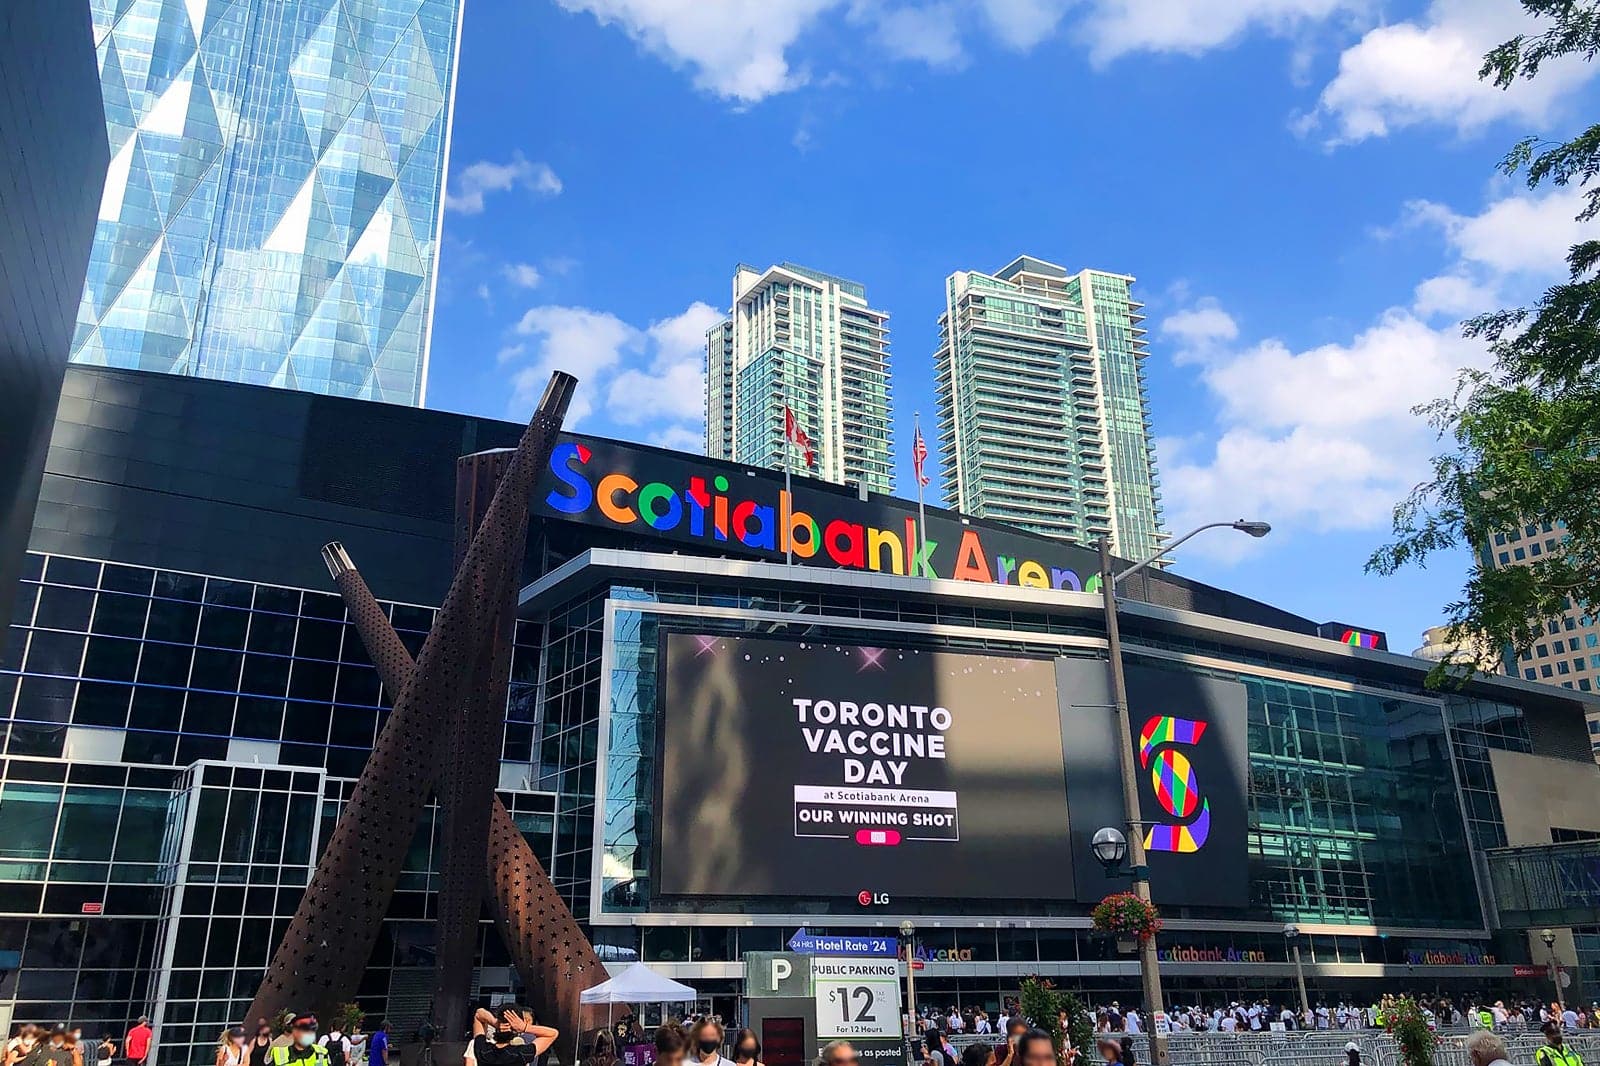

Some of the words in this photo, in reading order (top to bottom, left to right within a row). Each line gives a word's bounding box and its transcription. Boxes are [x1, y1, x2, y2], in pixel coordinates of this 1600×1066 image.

[545, 442, 939, 579] Scotiabank
[793, 698, 952, 731] TORONTO
[801, 727, 945, 760] VACCINE
[844, 758, 908, 786] DAY
[823, 791, 834, 800] at
[837, 791, 896, 802] Scotiabank
[899, 794, 930, 804] Arena
[798, 809, 834, 823] OUR
[838, 811, 908, 826] WINNING
[913, 813, 954, 827] SHOT
[874, 893, 890, 905] LG
[792, 940, 802, 948] 24
[816, 940, 844, 951] Hotel
[846, 941, 868, 951] Rate
[916, 945, 972, 962] Arena
[1158, 945, 1223, 962] cotiabank
[1227, 947, 1265, 962] Arena
[771, 959, 793, 991] P
[812, 965, 847, 976] PUBLIC
[849, 965, 896, 976] PARKING
[829, 986, 876, 1023] $12
[851, 1025, 860, 1033] 12
[861, 1025, 882, 1033] Hours
[875, 1046, 902, 1059] posted
